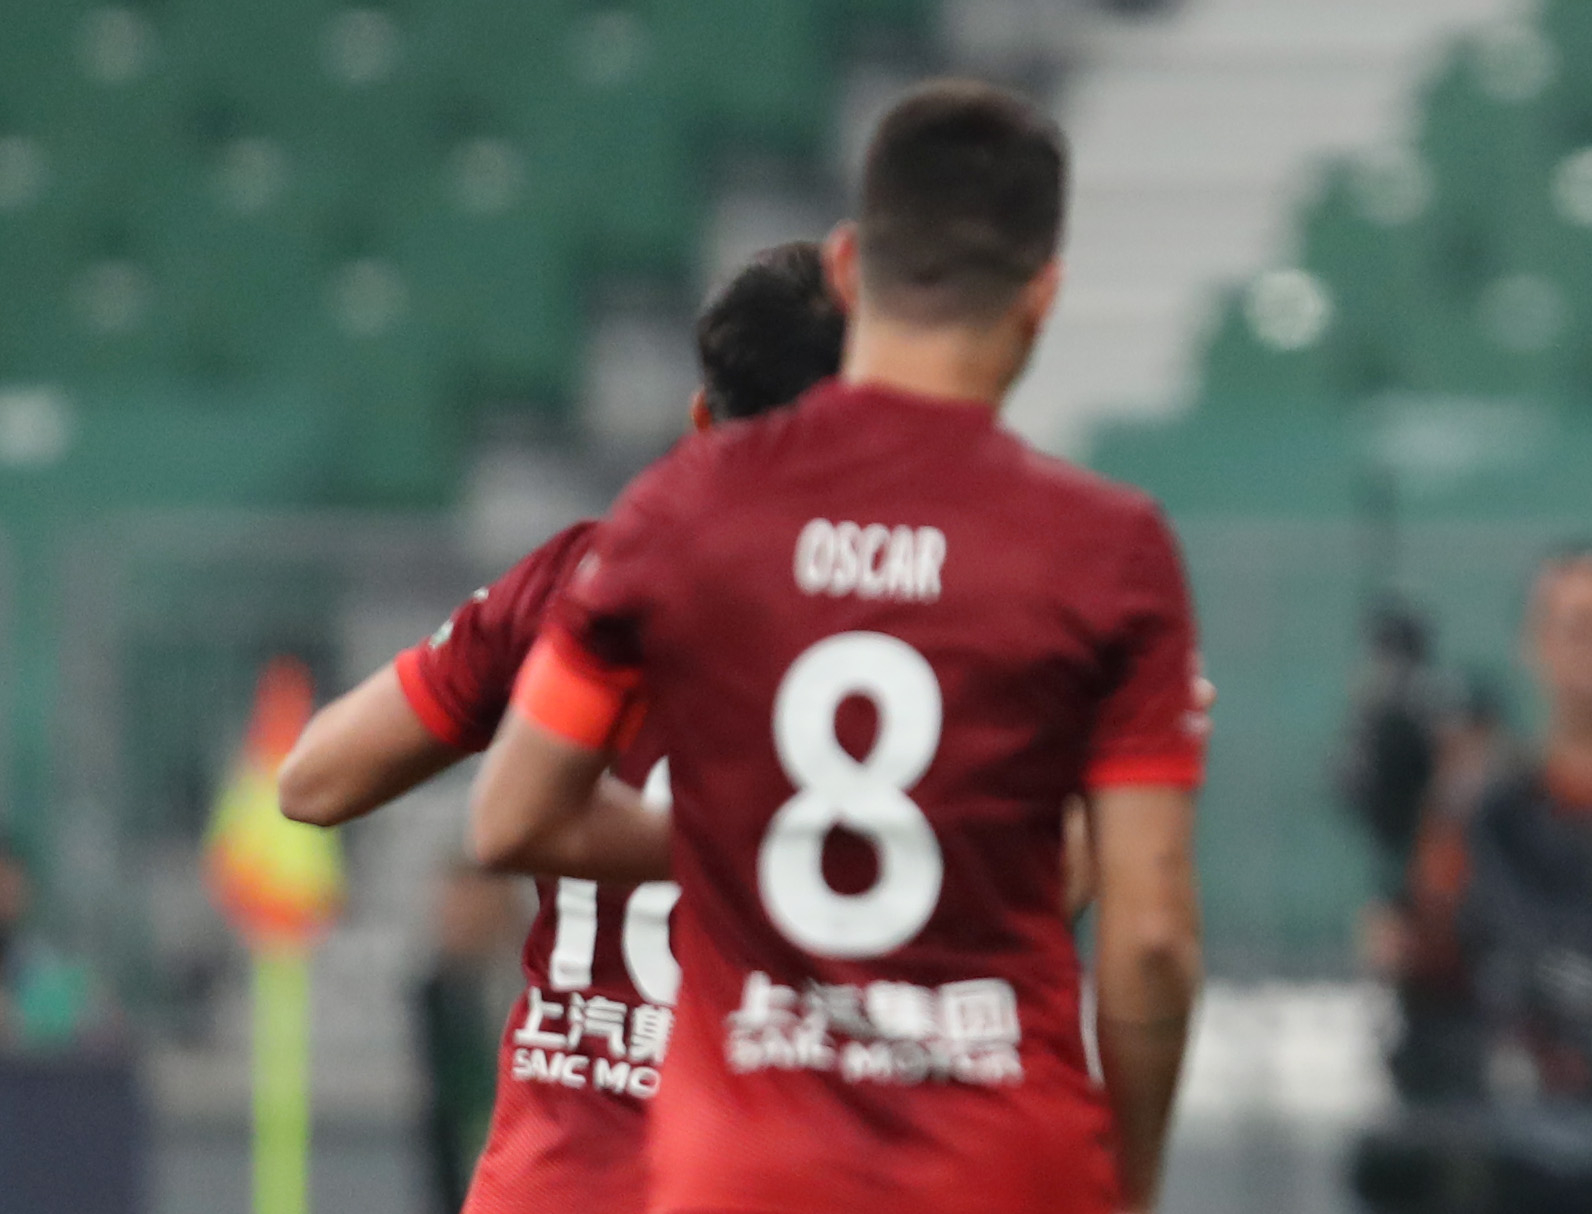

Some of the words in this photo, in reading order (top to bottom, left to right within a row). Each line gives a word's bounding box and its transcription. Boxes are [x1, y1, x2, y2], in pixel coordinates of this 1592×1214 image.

[794, 517, 947, 604] OSCAR
[757, 630, 944, 960] 8
[512, 1048, 589, 1088] SAIC
